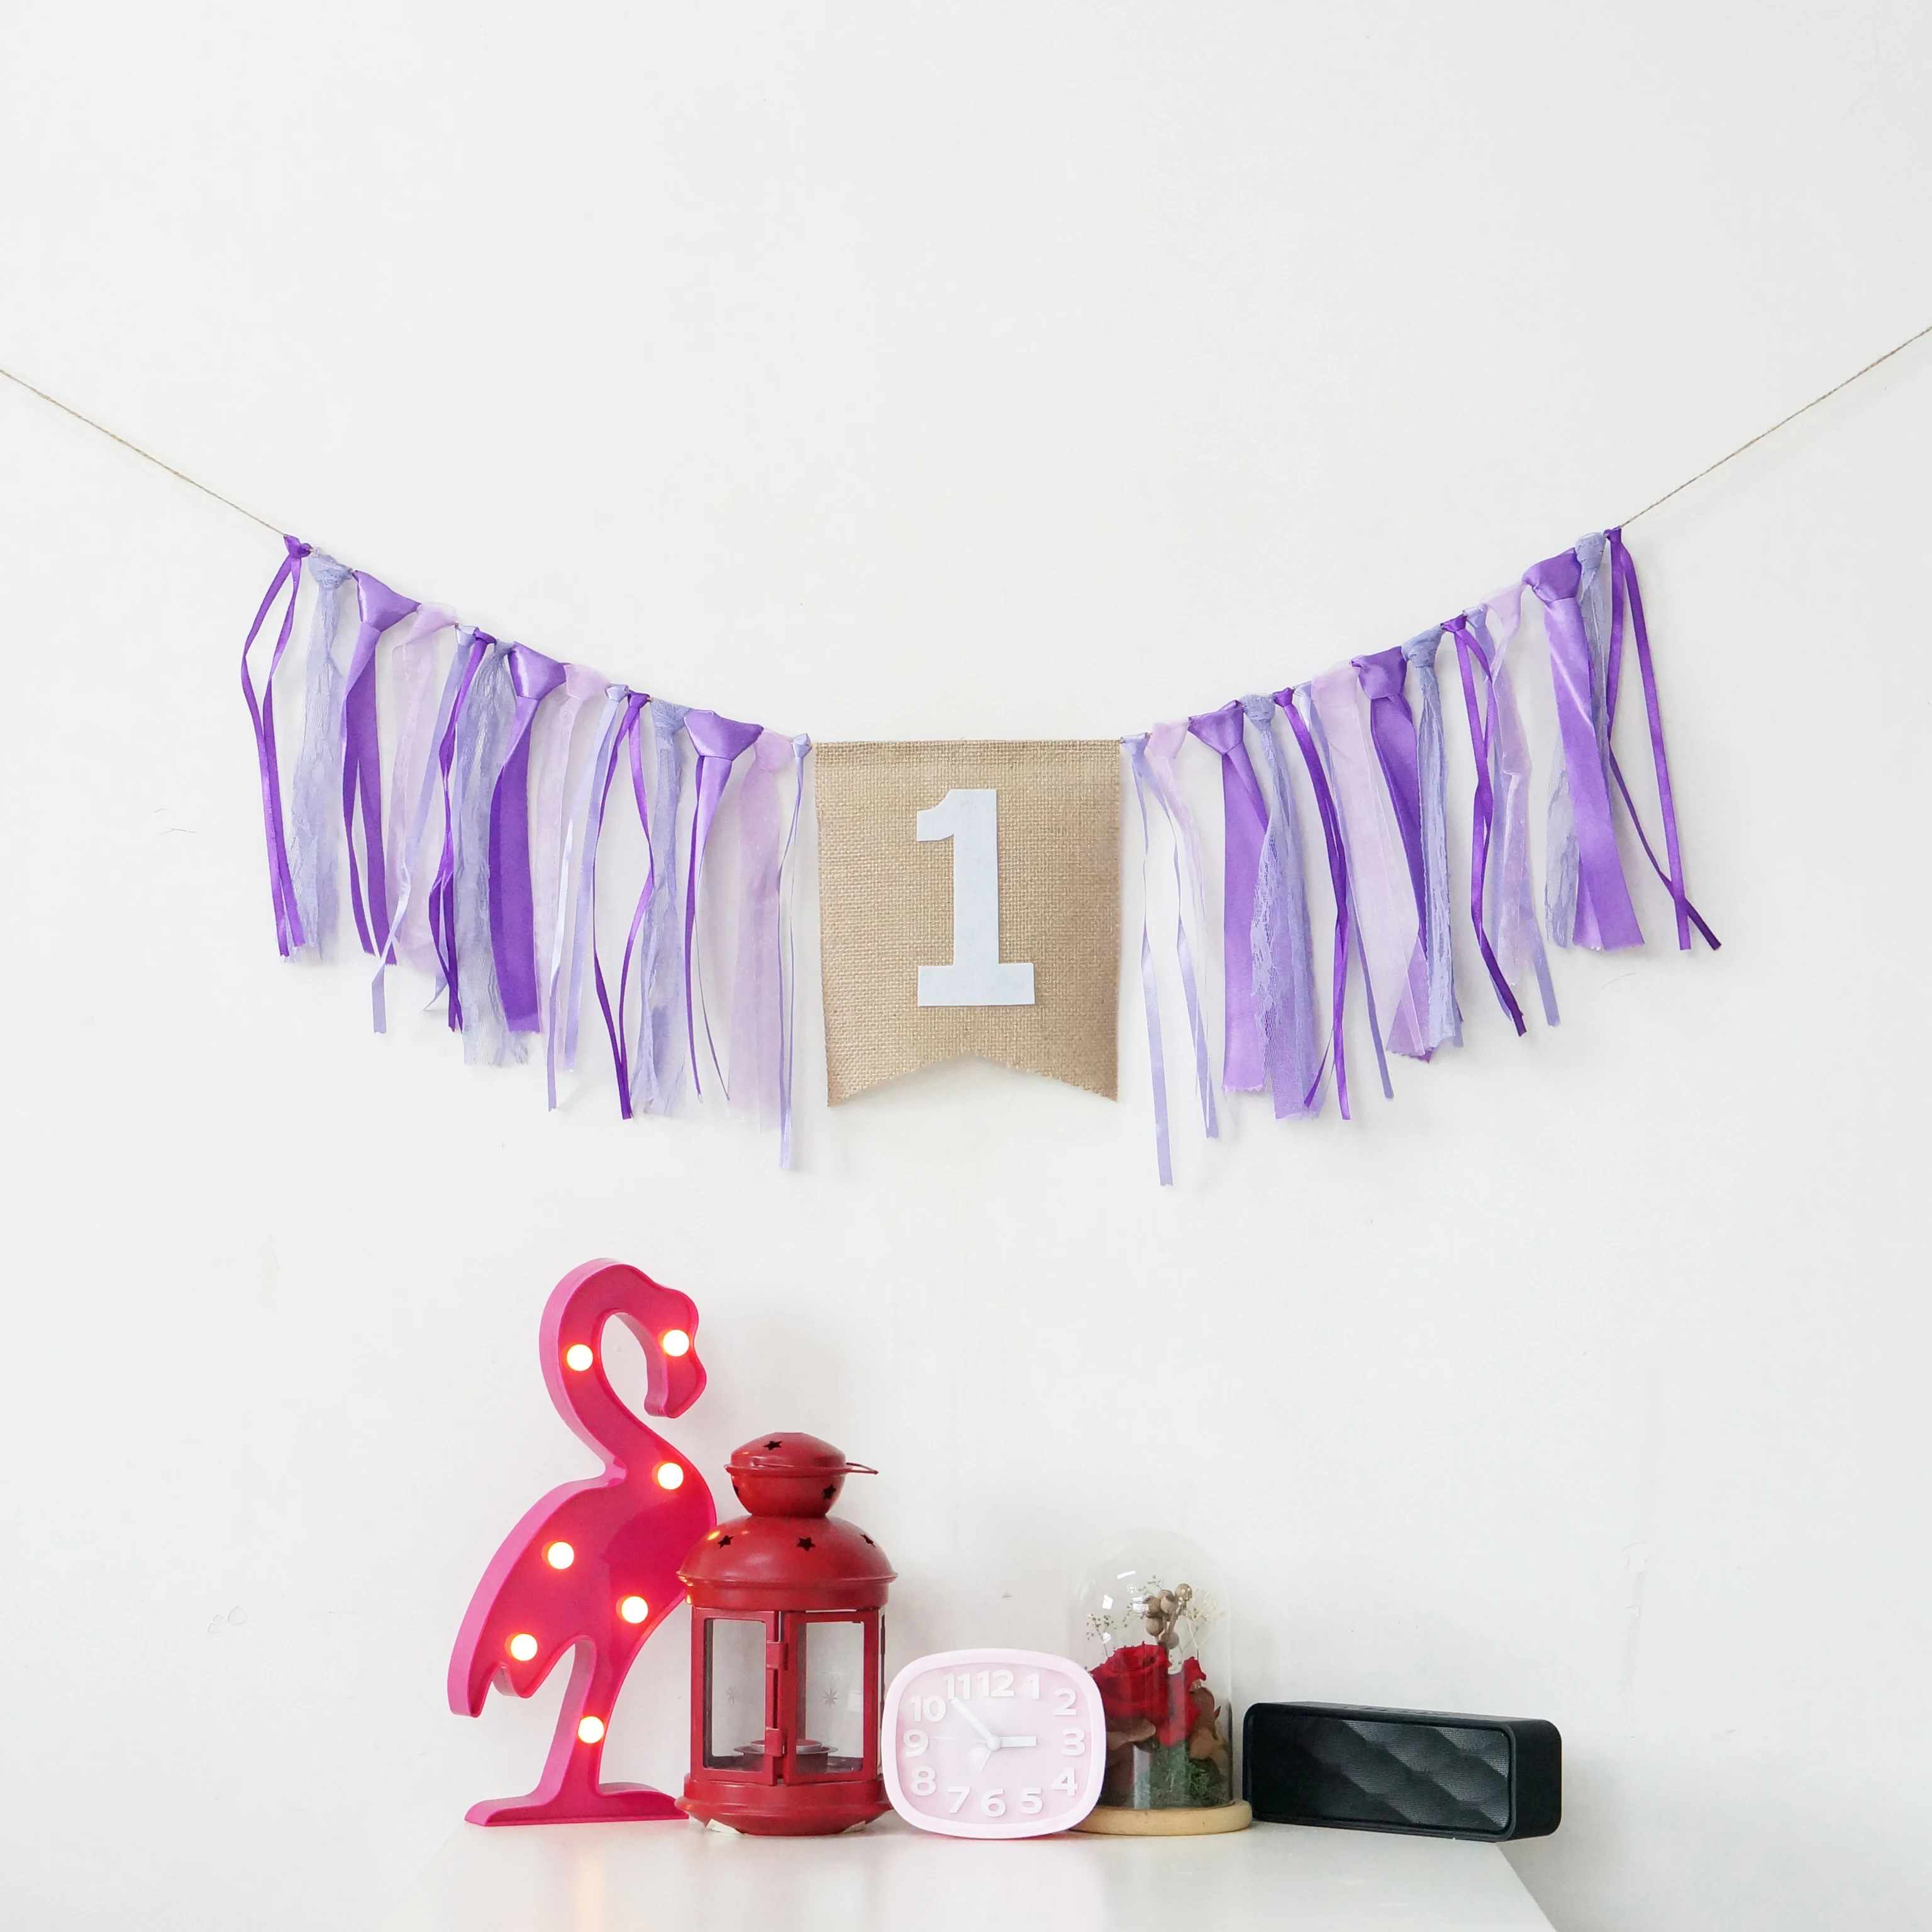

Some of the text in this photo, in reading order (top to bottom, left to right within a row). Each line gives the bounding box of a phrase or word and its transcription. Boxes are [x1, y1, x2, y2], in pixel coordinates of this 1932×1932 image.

[917, 789, 1035, 1006] 1
[943, 1673, 971, 1699] 11
[977, 1670, 1014, 1698] 12
[1027, 1674, 1040, 1699] 1
[909, 1695, 947, 1723] 10
[1053, 1688, 1077, 1716] 2
[903, 1729, 930, 1757] 9
[1061, 1728, 1086, 1756] 3
[910, 1766, 936, 1796] 8
[1051, 1767, 1078, 1796] 4
[947, 1786, 970, 1814] 7
[980, 1789, 1006, 1818] 6
[1019, 1787, 1043, 1814] 5
